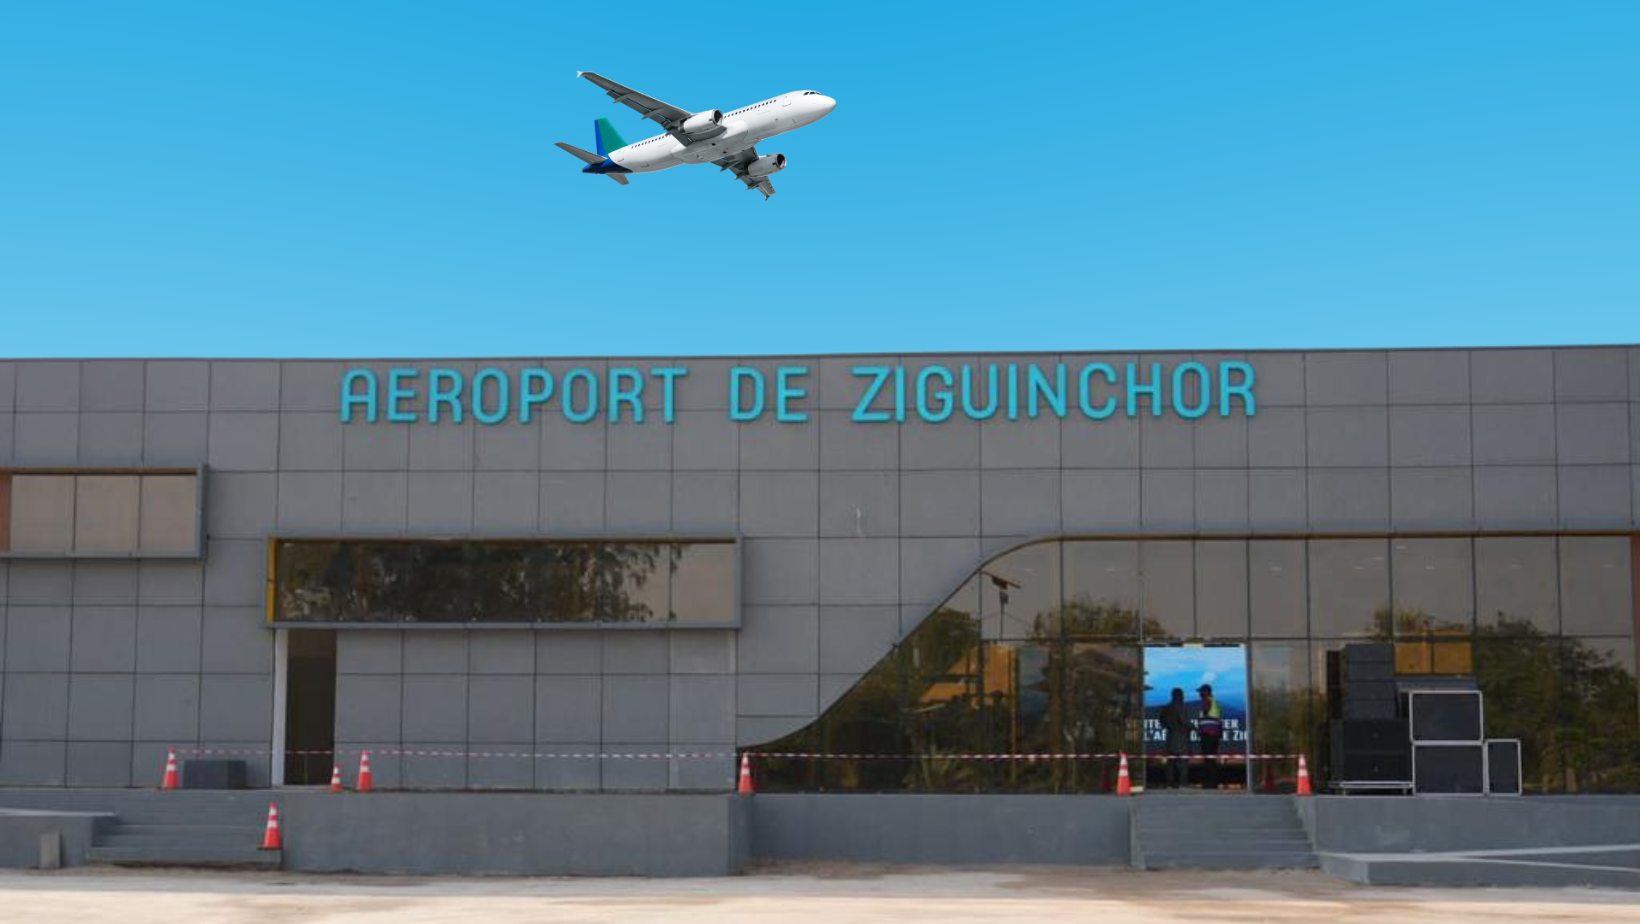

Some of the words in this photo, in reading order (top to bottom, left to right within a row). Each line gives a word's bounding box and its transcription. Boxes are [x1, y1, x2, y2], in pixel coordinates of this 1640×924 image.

[340, 367, 690, 426] AEROPORT
[728, 366, 810, 424] DE
[850, 360, 1257, 424] ZIGUINCHOR
